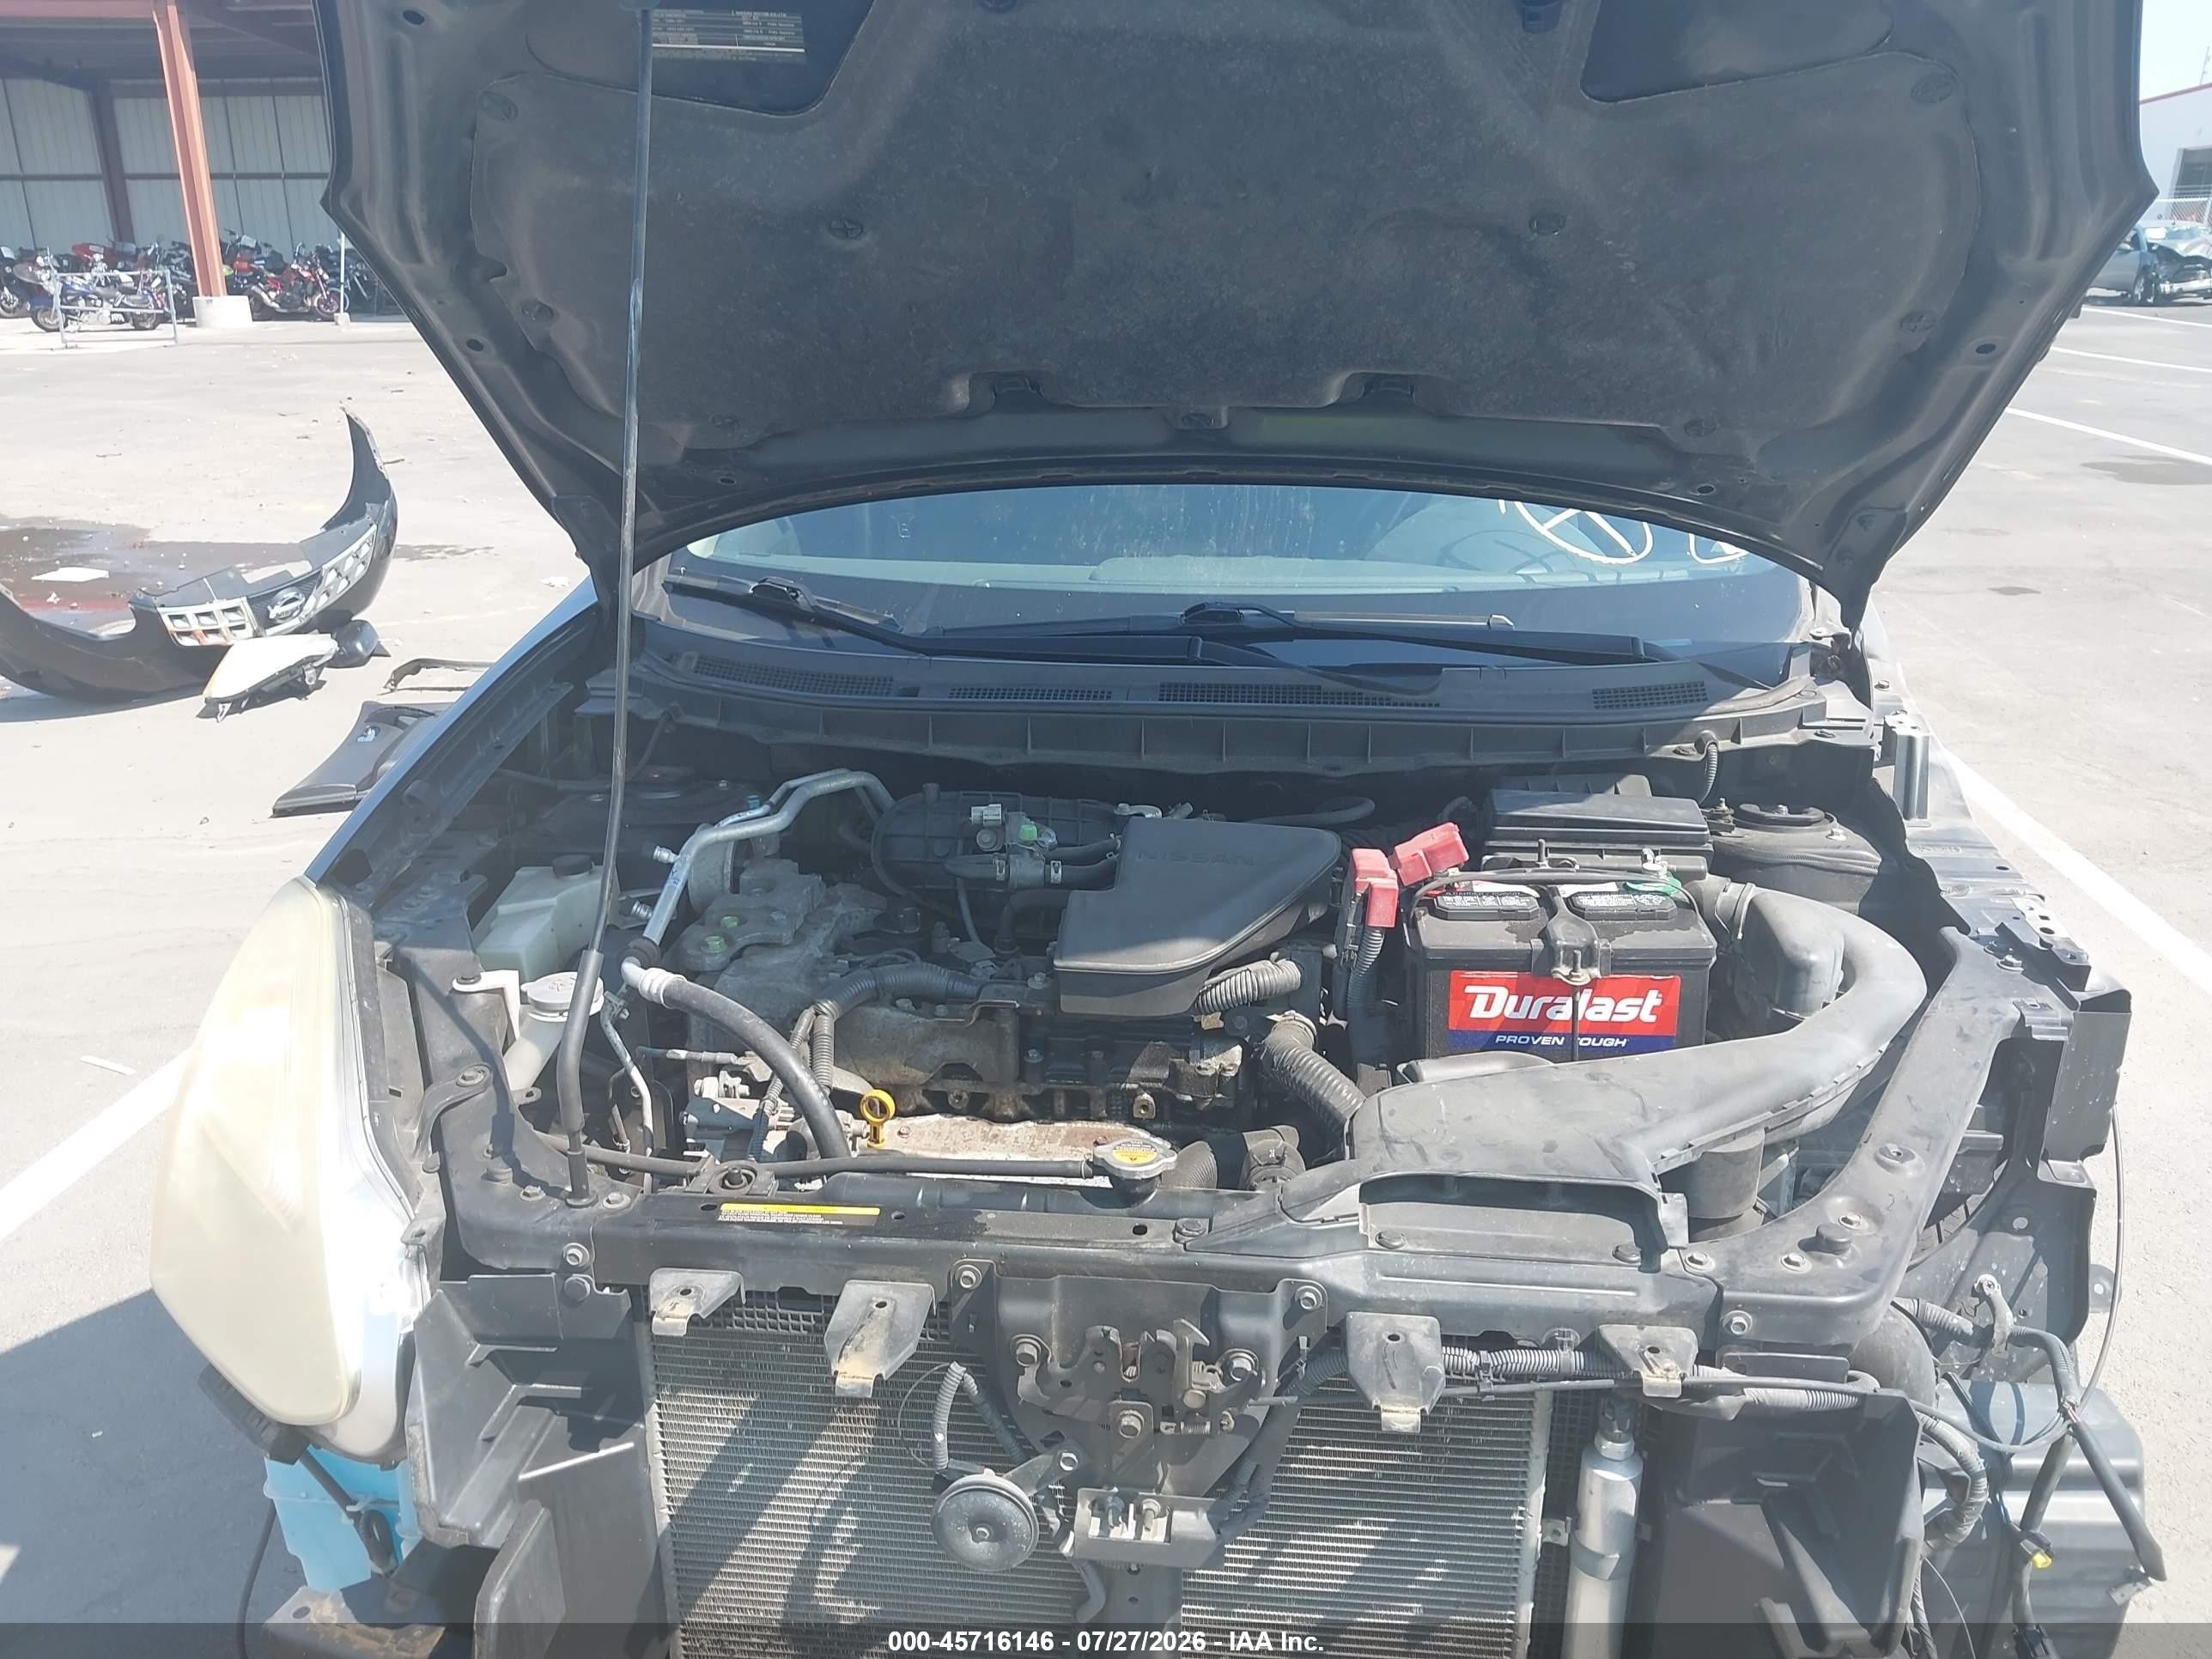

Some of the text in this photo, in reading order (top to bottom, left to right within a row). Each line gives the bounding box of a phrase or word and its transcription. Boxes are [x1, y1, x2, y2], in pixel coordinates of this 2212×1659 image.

[1134, 849, 1255, 866] NISSAN
[1464, 985, 1663, 1023] Duralast
[1495, 1036, 1565, 1046] PROVEN
